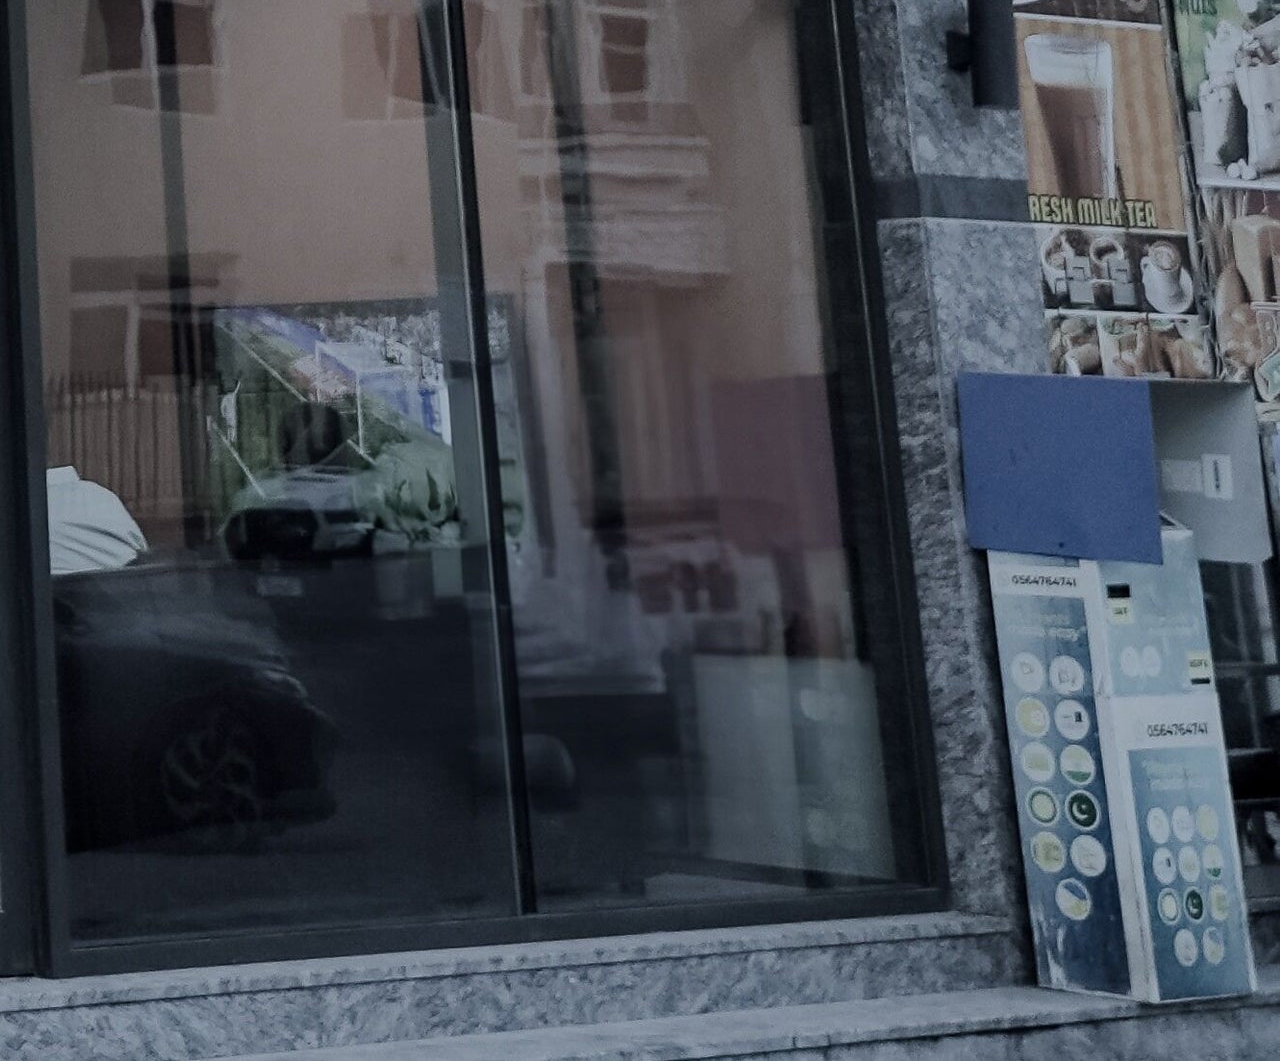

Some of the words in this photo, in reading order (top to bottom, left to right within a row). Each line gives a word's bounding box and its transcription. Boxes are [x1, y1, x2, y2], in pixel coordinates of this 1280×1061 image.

[1027, 194, 1074, 224] RESH
[1076, 198, 1122, 227] MILK
[1124, 200, 1158, 229] TEA
